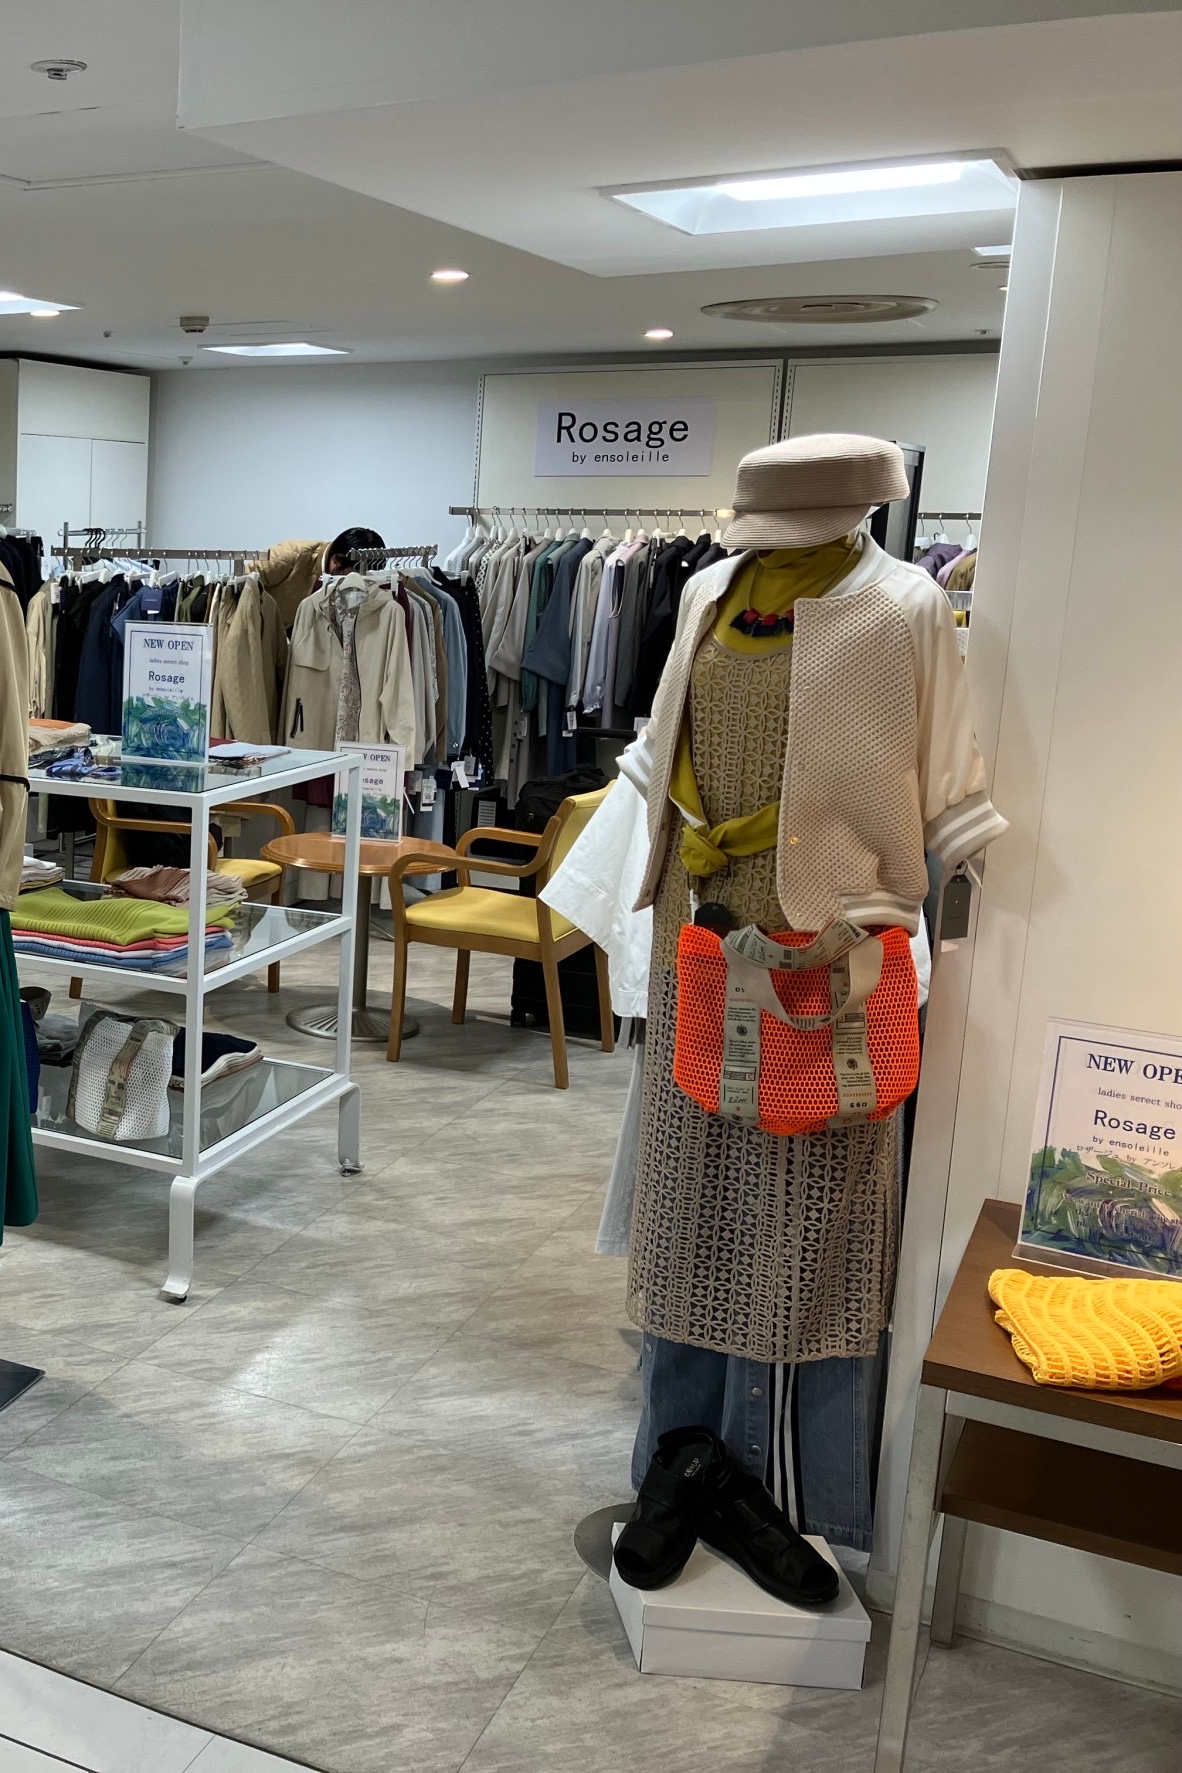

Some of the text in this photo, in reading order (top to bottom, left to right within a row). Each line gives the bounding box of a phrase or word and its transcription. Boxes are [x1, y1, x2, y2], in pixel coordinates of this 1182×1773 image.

[556, 412, 689, 449] Rosage
[572, 450, 669, 464] by ensoleille
[143, 638, 195, 651] NEW OPEN
[148, 671, 185, 685] Rosage
[369, 754, 391, 762] OPEN
[363, 777, 383, 785] sage
[1086, 1053, 1135, 1075] NEW
[1098, 1087, 1126, 1100] ladies
[1130, 1094, 1161, 1107] serect
[1093, 1109, 1176, 1140] Rosage
[1092, 1135, 1170, 1156] by ensoleille
[1126, 1154, 1137, 1163] by
[1144, 1157, 1182, 1171] アンソレ
[1086, 1171, 1172, 1197] Special Price
